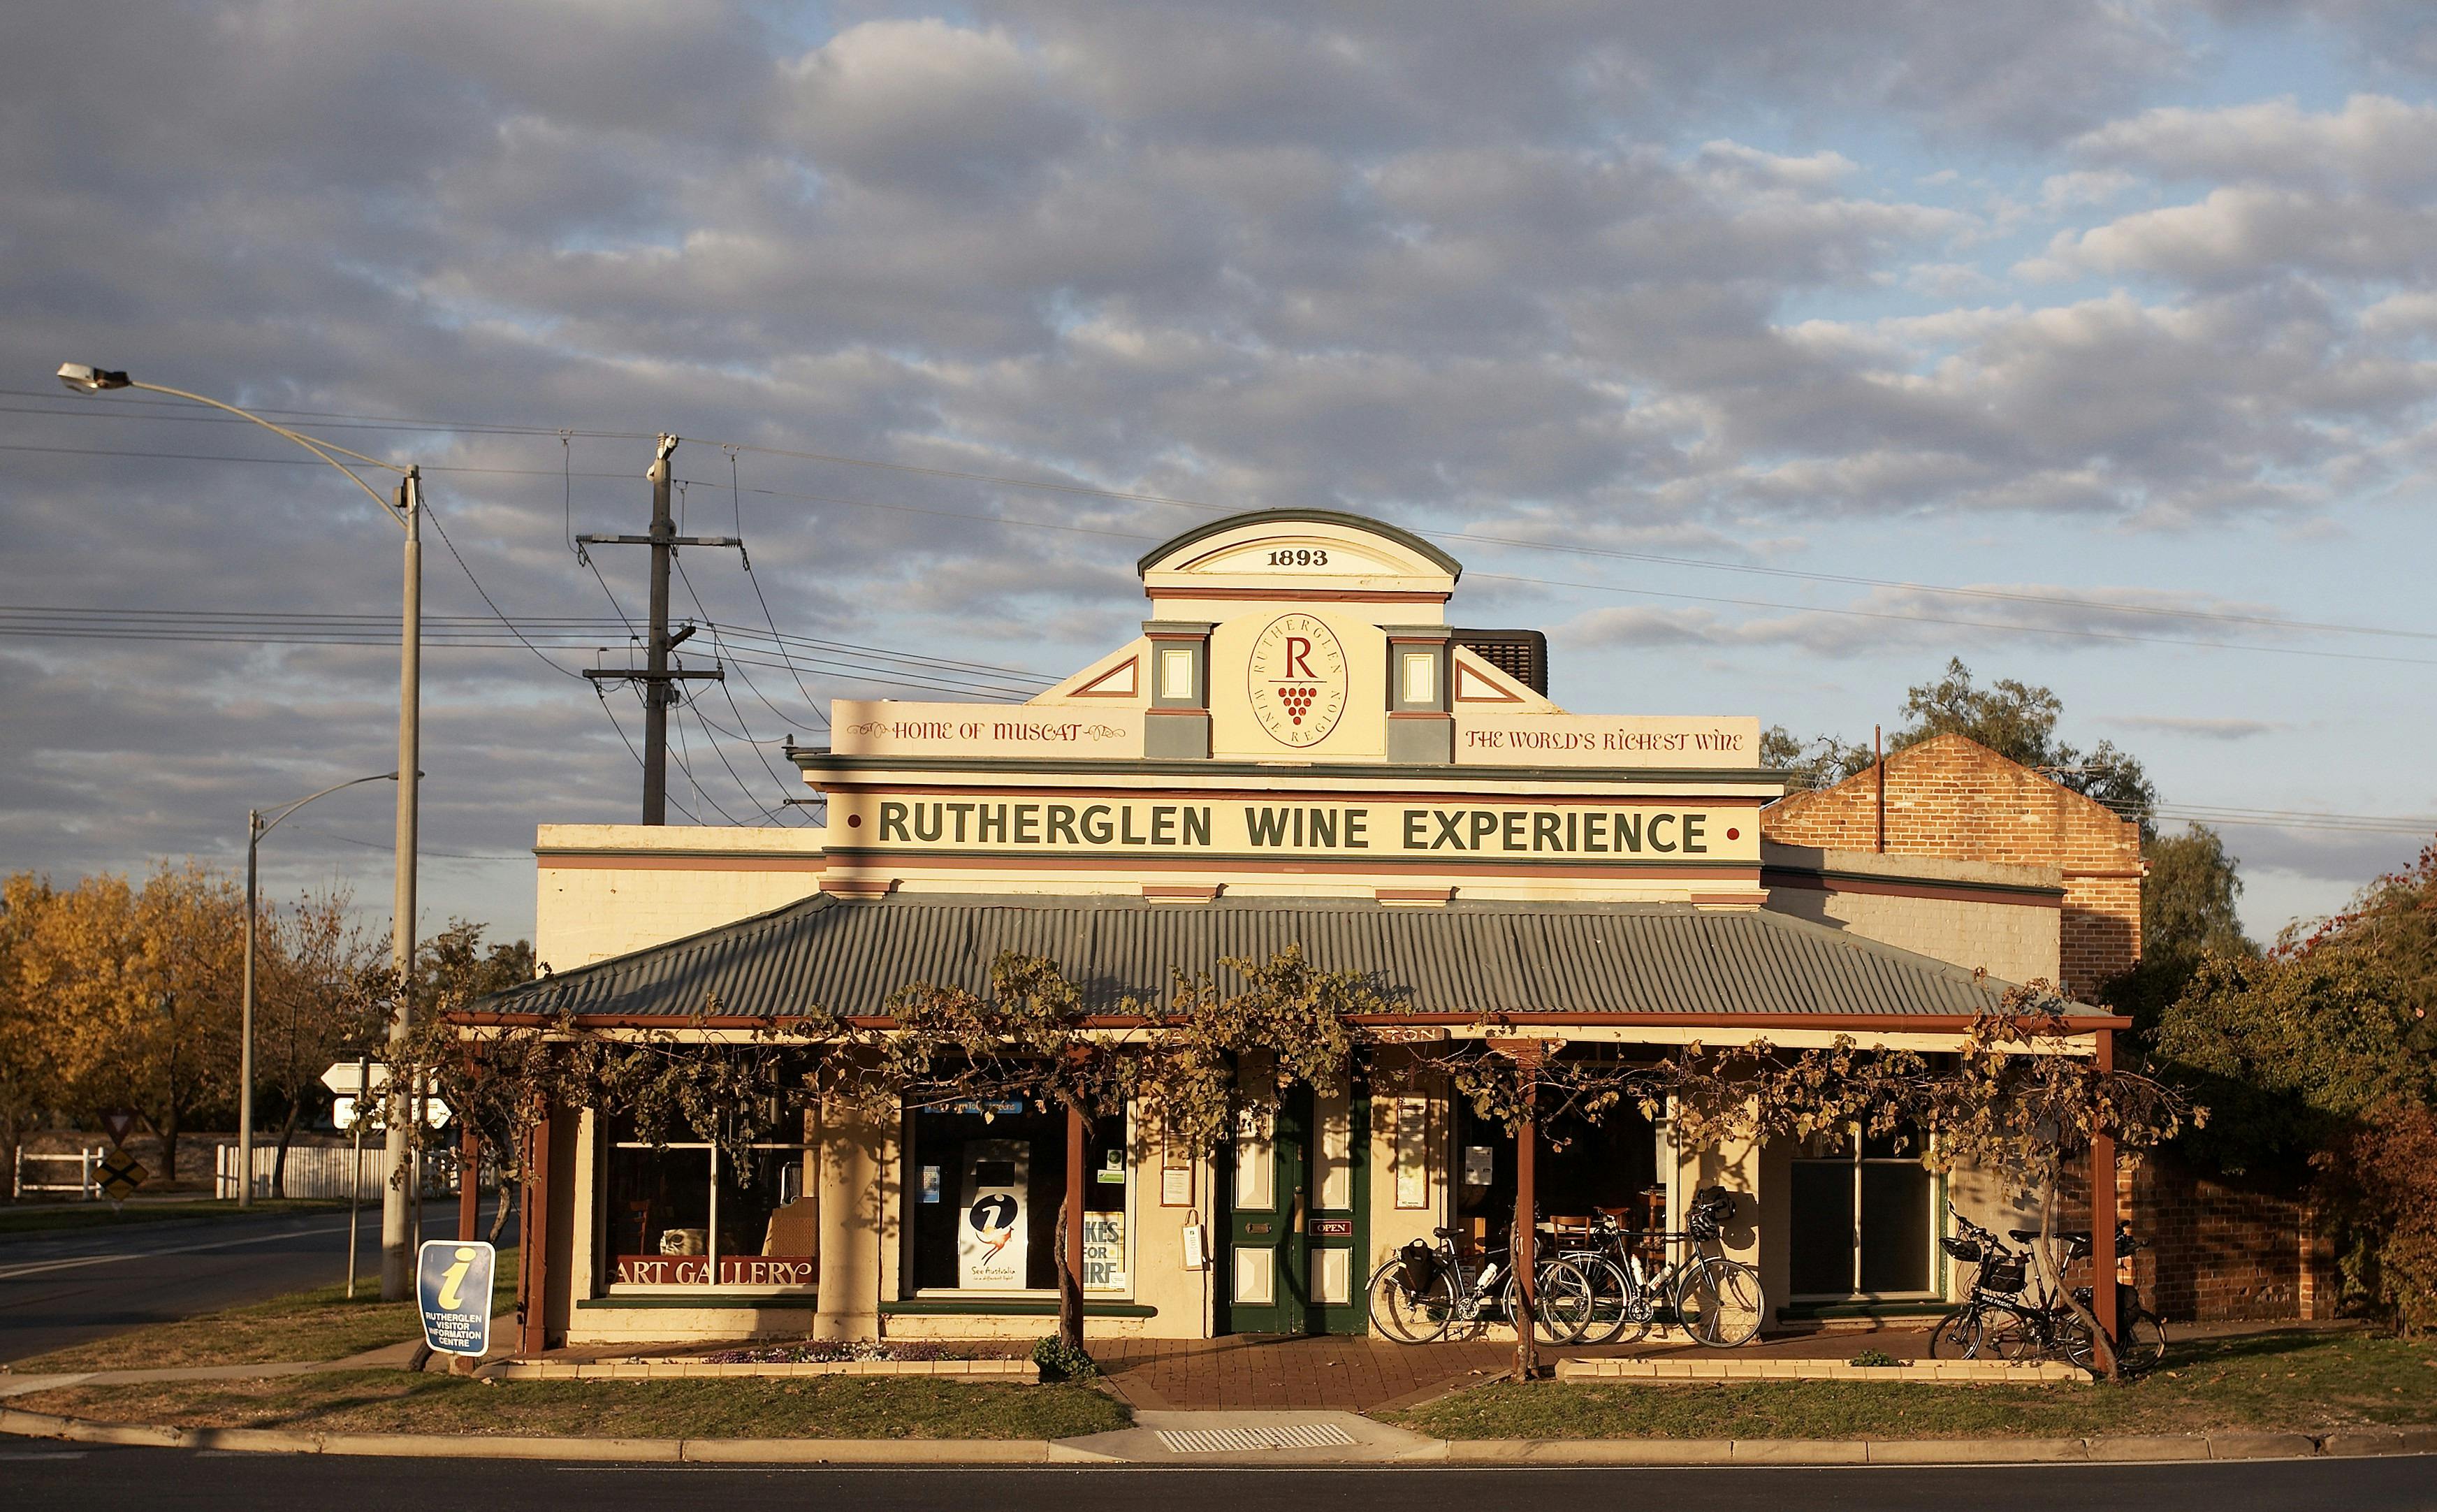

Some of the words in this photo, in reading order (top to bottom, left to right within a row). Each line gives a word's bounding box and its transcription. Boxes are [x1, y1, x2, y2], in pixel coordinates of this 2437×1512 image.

[1267, 550, 1328, 566] 1893
[1253, 619, 1342, 674] RUTHERGLEN
[1286, 637, 1319, 678] R
[1254, 689, 1282, 733] WINE
[1291, 690, 1341, 742] REGION
[893, 722, 953, 739] HOME
[959, 722, 985, 740] OF
[993, 723, 1082, 741] MUSCAT
[1466, 731, 1504, 748] THE
[1508, 732, 1595, 750] WORLD'S
[1603, 729, 1689, 750] RICHEST
[1694, 729, 1744, 751] WINE
[880, 802, 1211, 845] RUTHERGLEN
[1245, 808, 1369, 848] WINE
[1404, 810, 1708, 853] EXPERIENCE
[1317, 1223, 1346, 1232] OPEN
[616, 1262, 669, 1285] ART
[676, 1262, 813, 1286] GALLERY
[971, 1266, 984, 1275] See
[425, 1311, 482, 1323] RUTHERGLEN
[436, 1321, 470, 1330] VISITOR
[428, 1328, 481, 1339] INFORMATION
[439, 1337, 470, 1347] CENTRE
